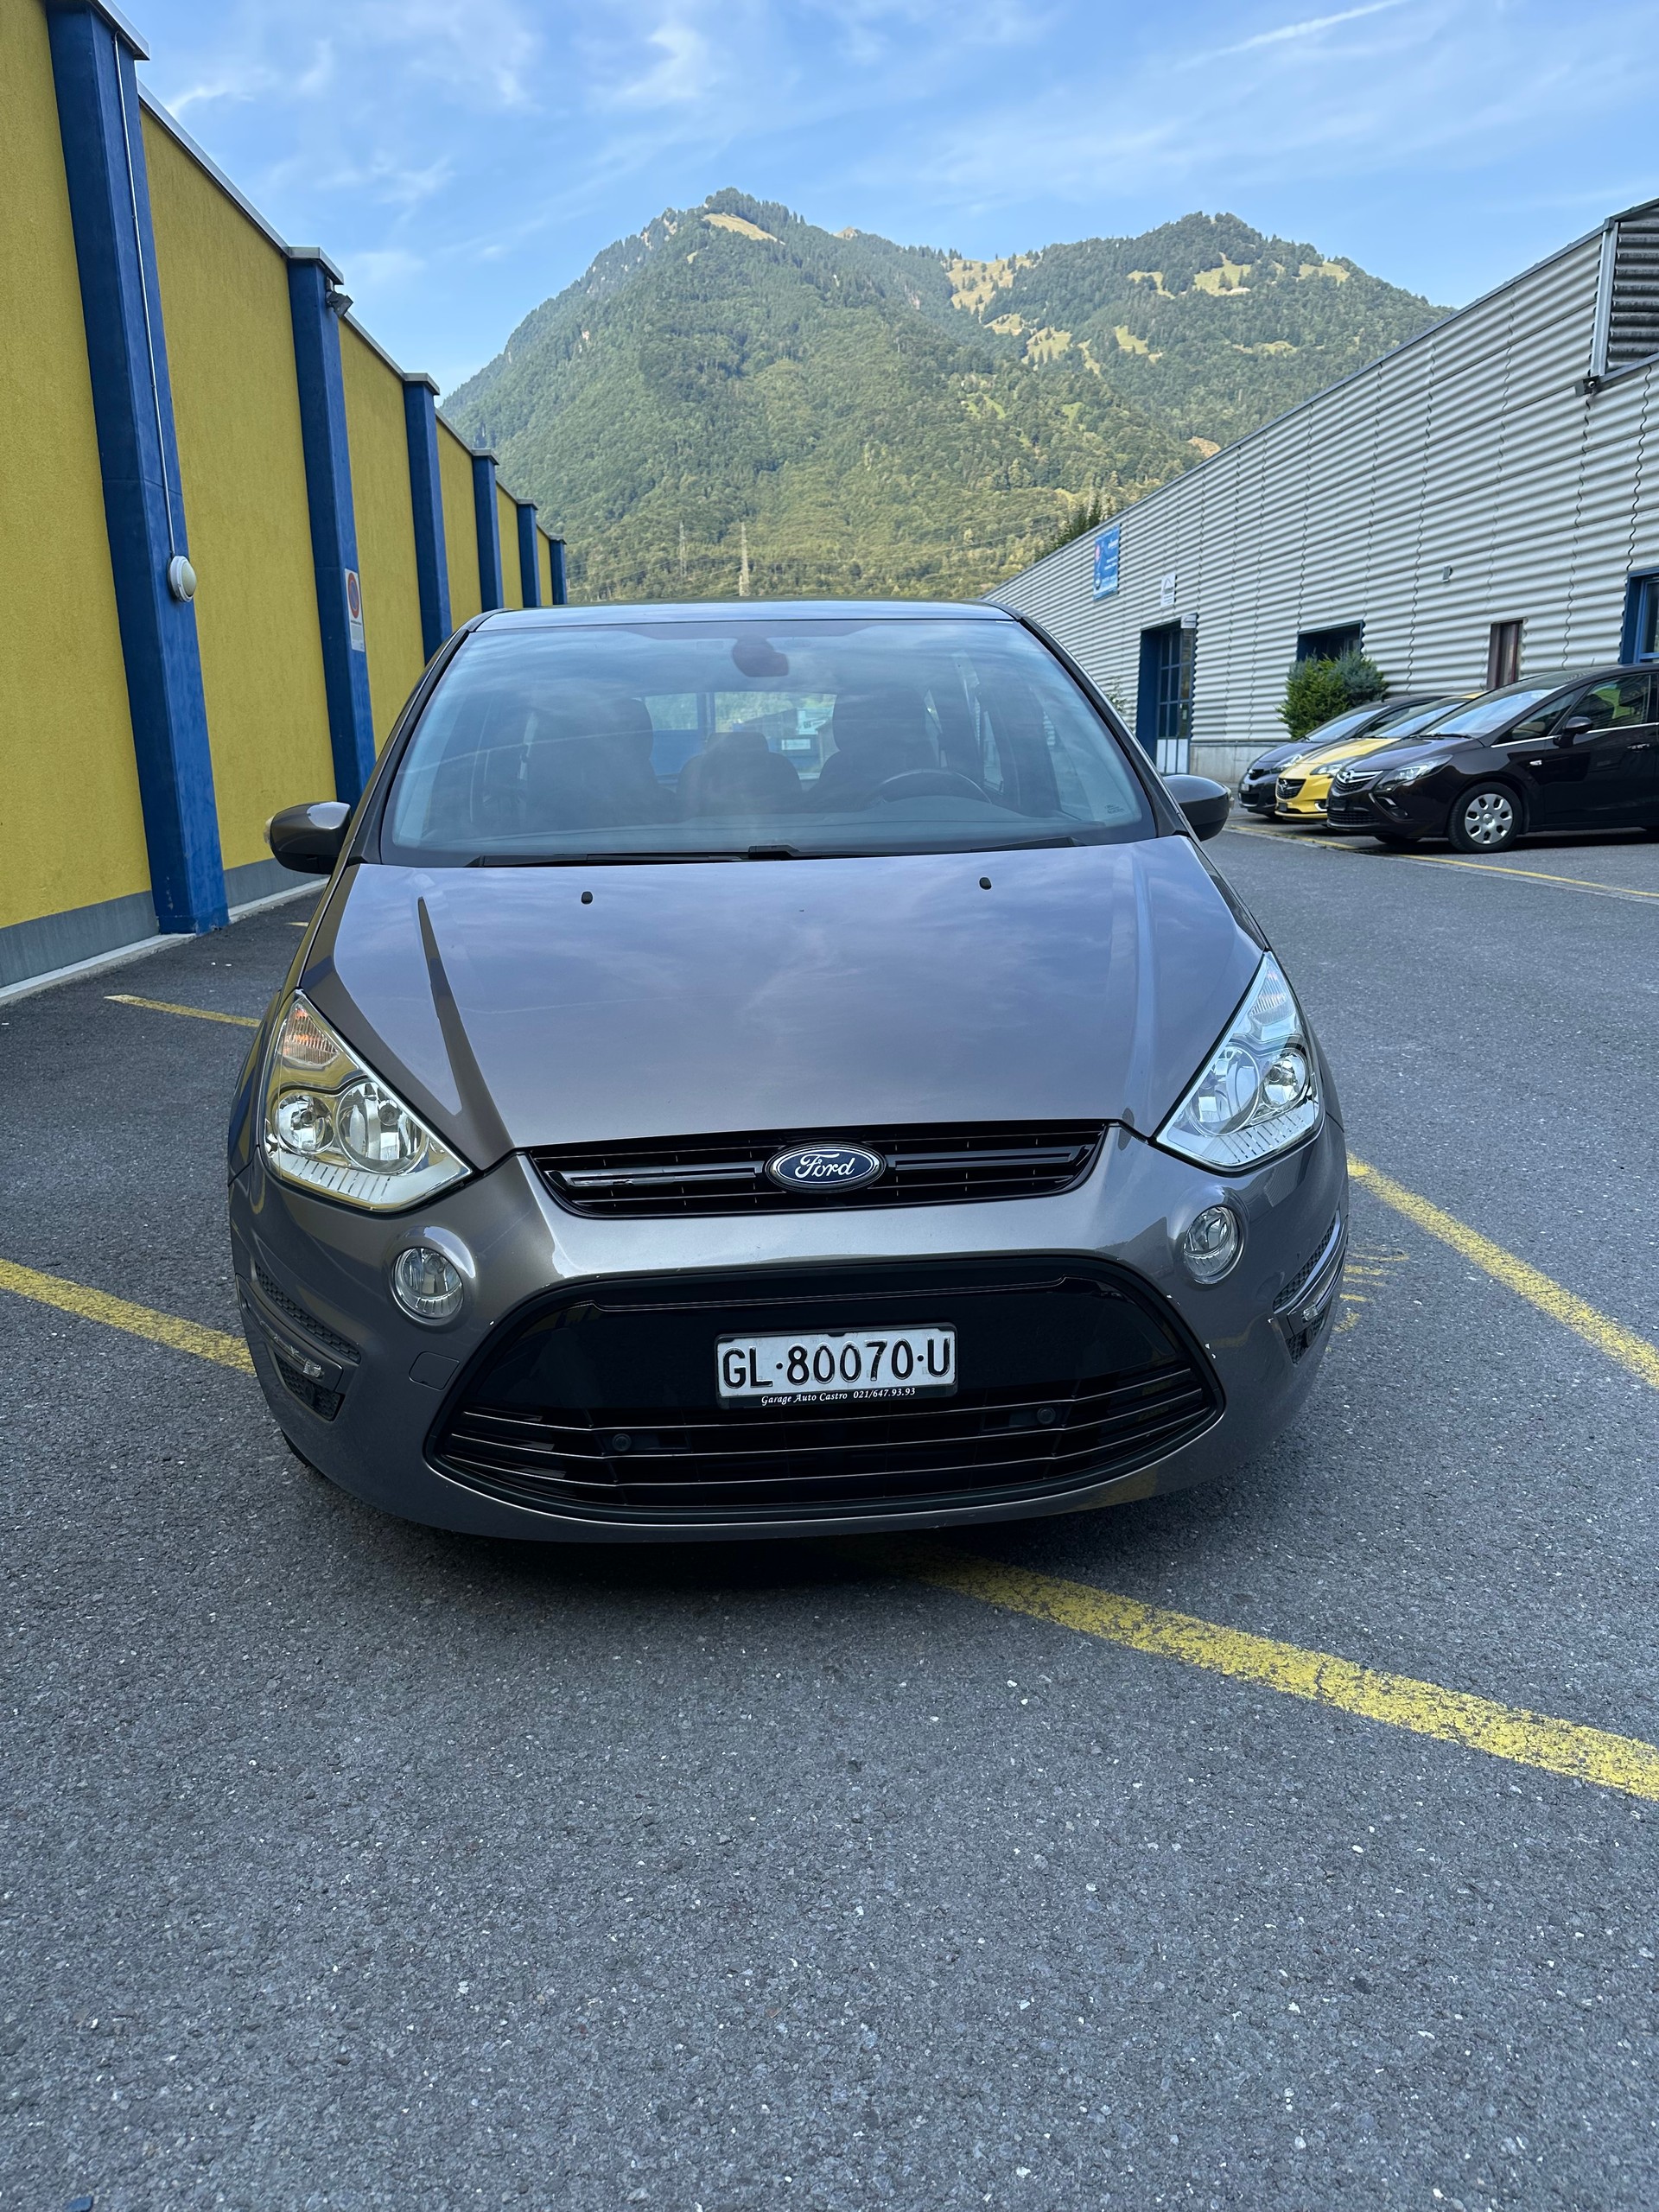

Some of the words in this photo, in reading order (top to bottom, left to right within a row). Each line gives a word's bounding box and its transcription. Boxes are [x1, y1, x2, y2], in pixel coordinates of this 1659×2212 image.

[794, 1153, 855, 1179] Ford
[761, 1395, 792, 1407] Garage
[793, 1394, 817, 1403] Auto
[819, 1392, 848, 1402] Castro
[853, 1387, 916, 1399] 021/647.93.93
